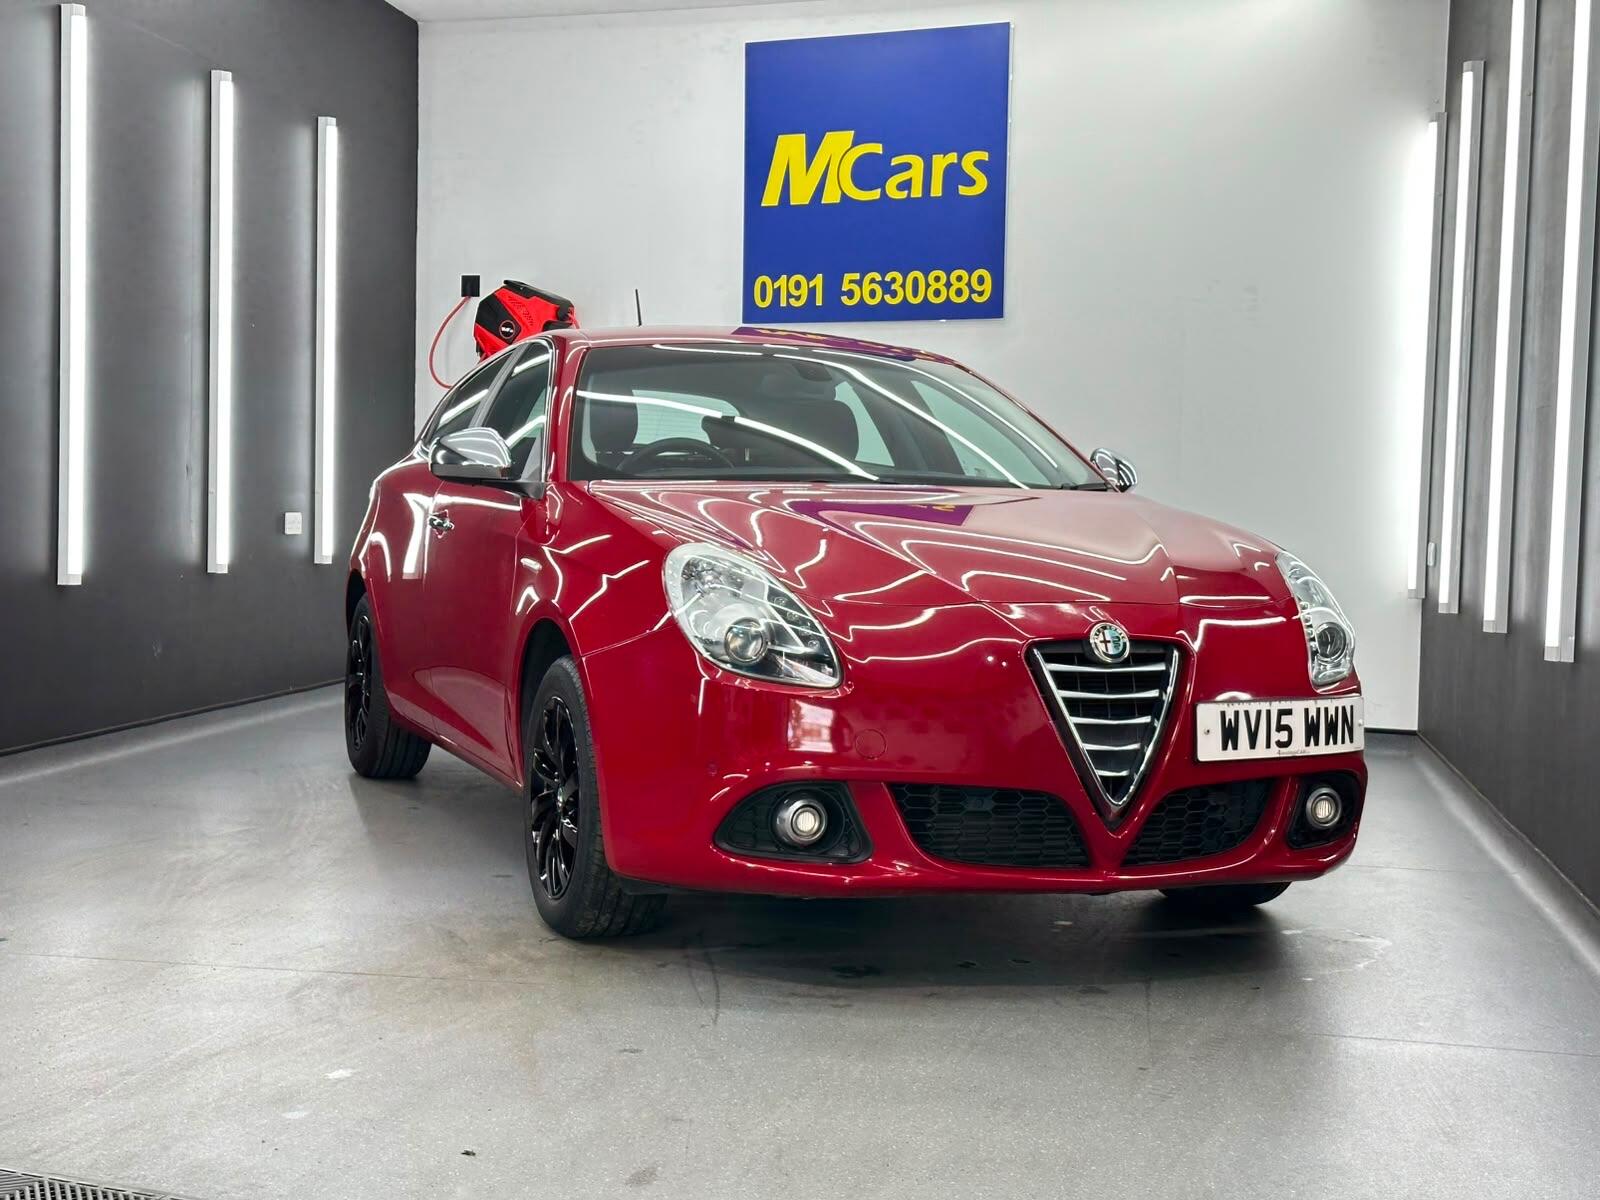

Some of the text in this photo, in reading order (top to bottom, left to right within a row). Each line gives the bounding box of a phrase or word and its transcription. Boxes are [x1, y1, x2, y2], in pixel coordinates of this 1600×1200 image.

[753, 269, 992, 307] 0191 5630889
[1220, 705, 1354, 751] WV15 WWN
